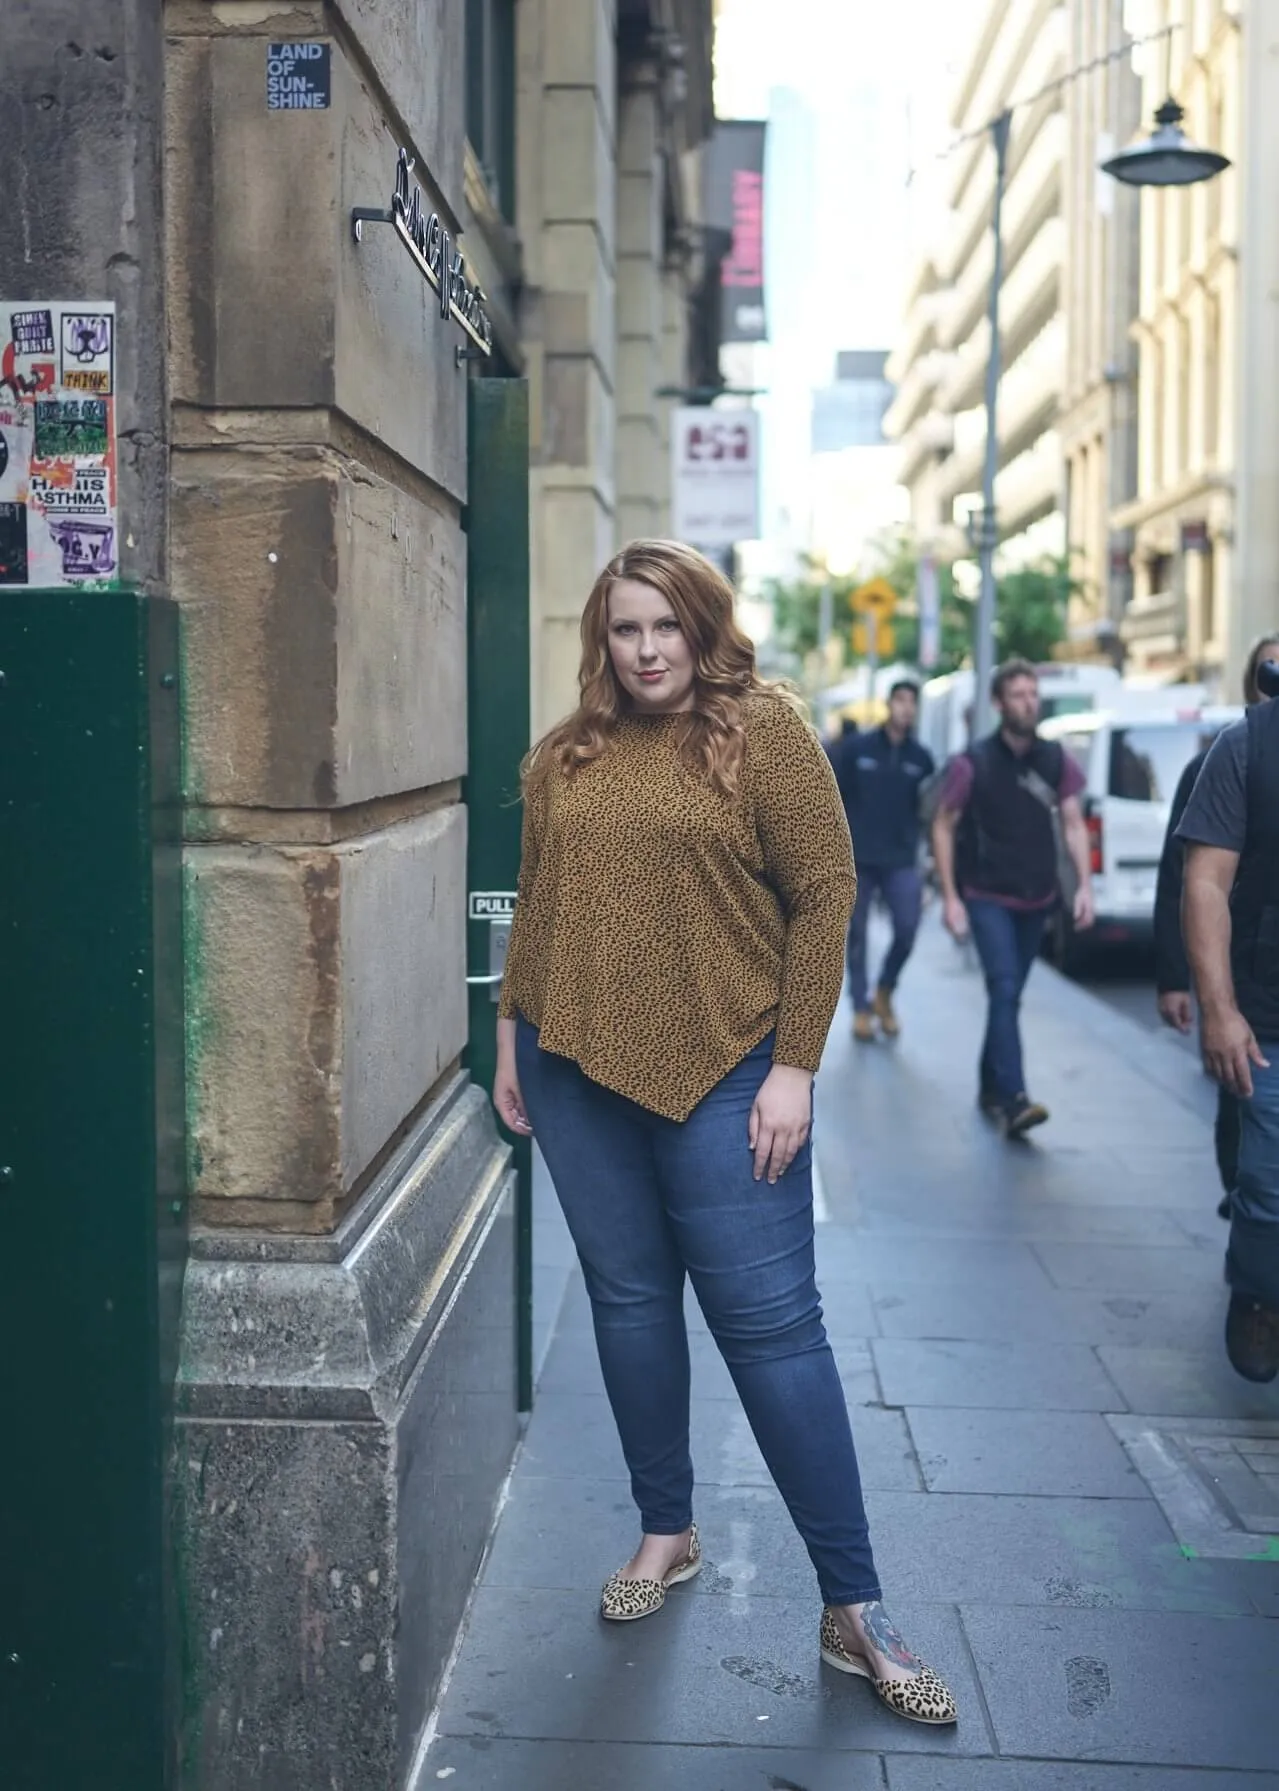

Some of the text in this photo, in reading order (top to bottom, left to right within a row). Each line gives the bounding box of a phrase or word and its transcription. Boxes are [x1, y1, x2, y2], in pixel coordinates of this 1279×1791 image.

[267, 44, 323, 60] LAND
[267, 60, 296, 76] OF
[267, 76, 314, 92] SUN-
[267, 92, 326, 108] SHINE
[476, 899, 513, 913] PULL
